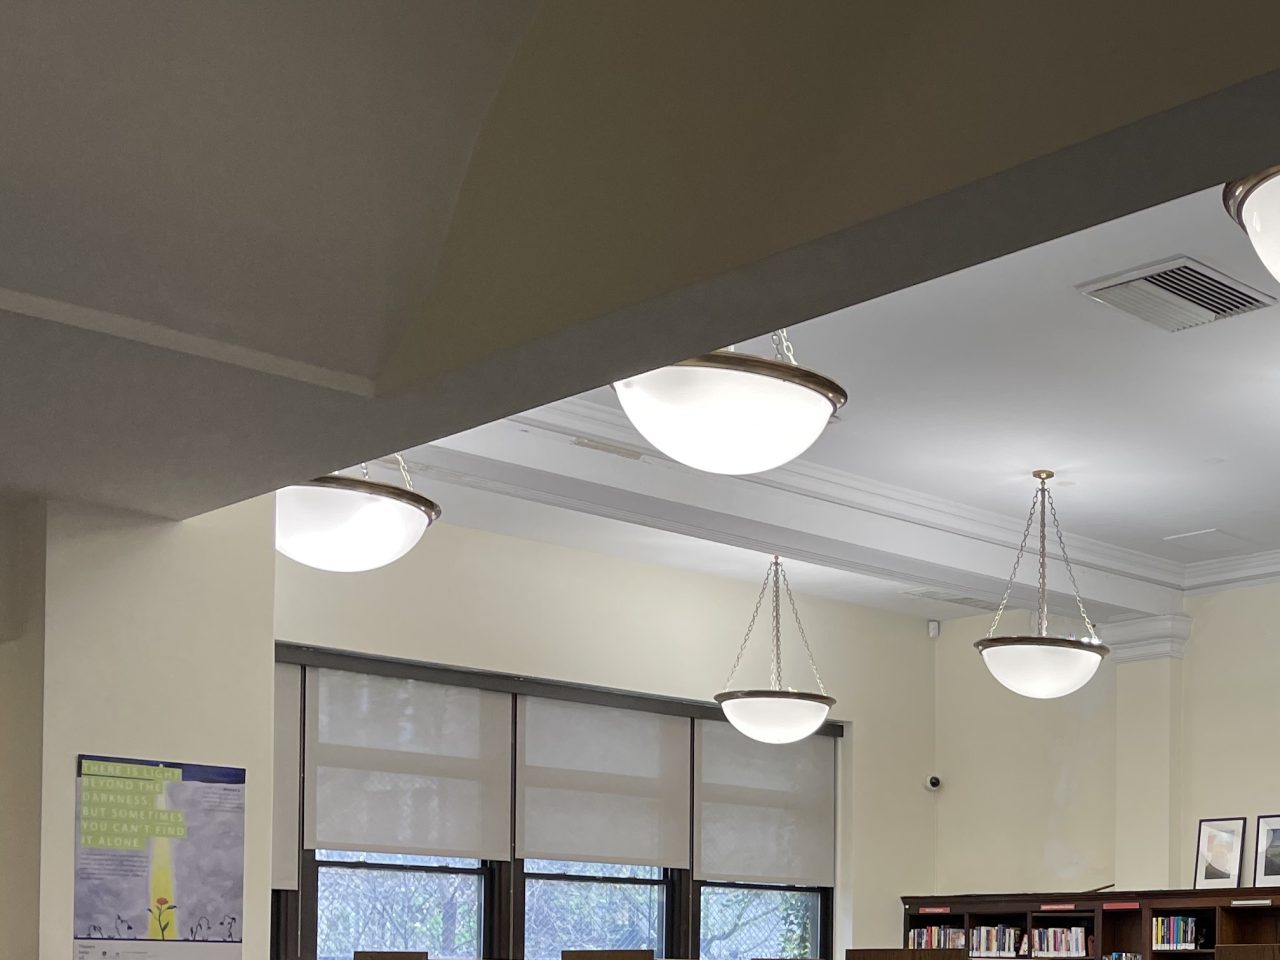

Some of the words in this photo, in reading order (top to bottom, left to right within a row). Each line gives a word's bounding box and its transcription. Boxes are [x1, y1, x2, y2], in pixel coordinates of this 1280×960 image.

[83, 764, 120, 776] THERE
[127, 768, 137, 776] IS
[144, 768, 180, 780] LIGHT
[83, 778, 134, 790] BEYOND
[139, 782, 162, 792] THE
[82, 806, 106, 816] BUT
[112, 808, 184, 822] SOMETIMES
[82, 822, 107, 832] YOU
[113, 824, 150, 832] CAN'T
[156, 826, 186, 836] FIND
[82, 836, 93, 845] IT
